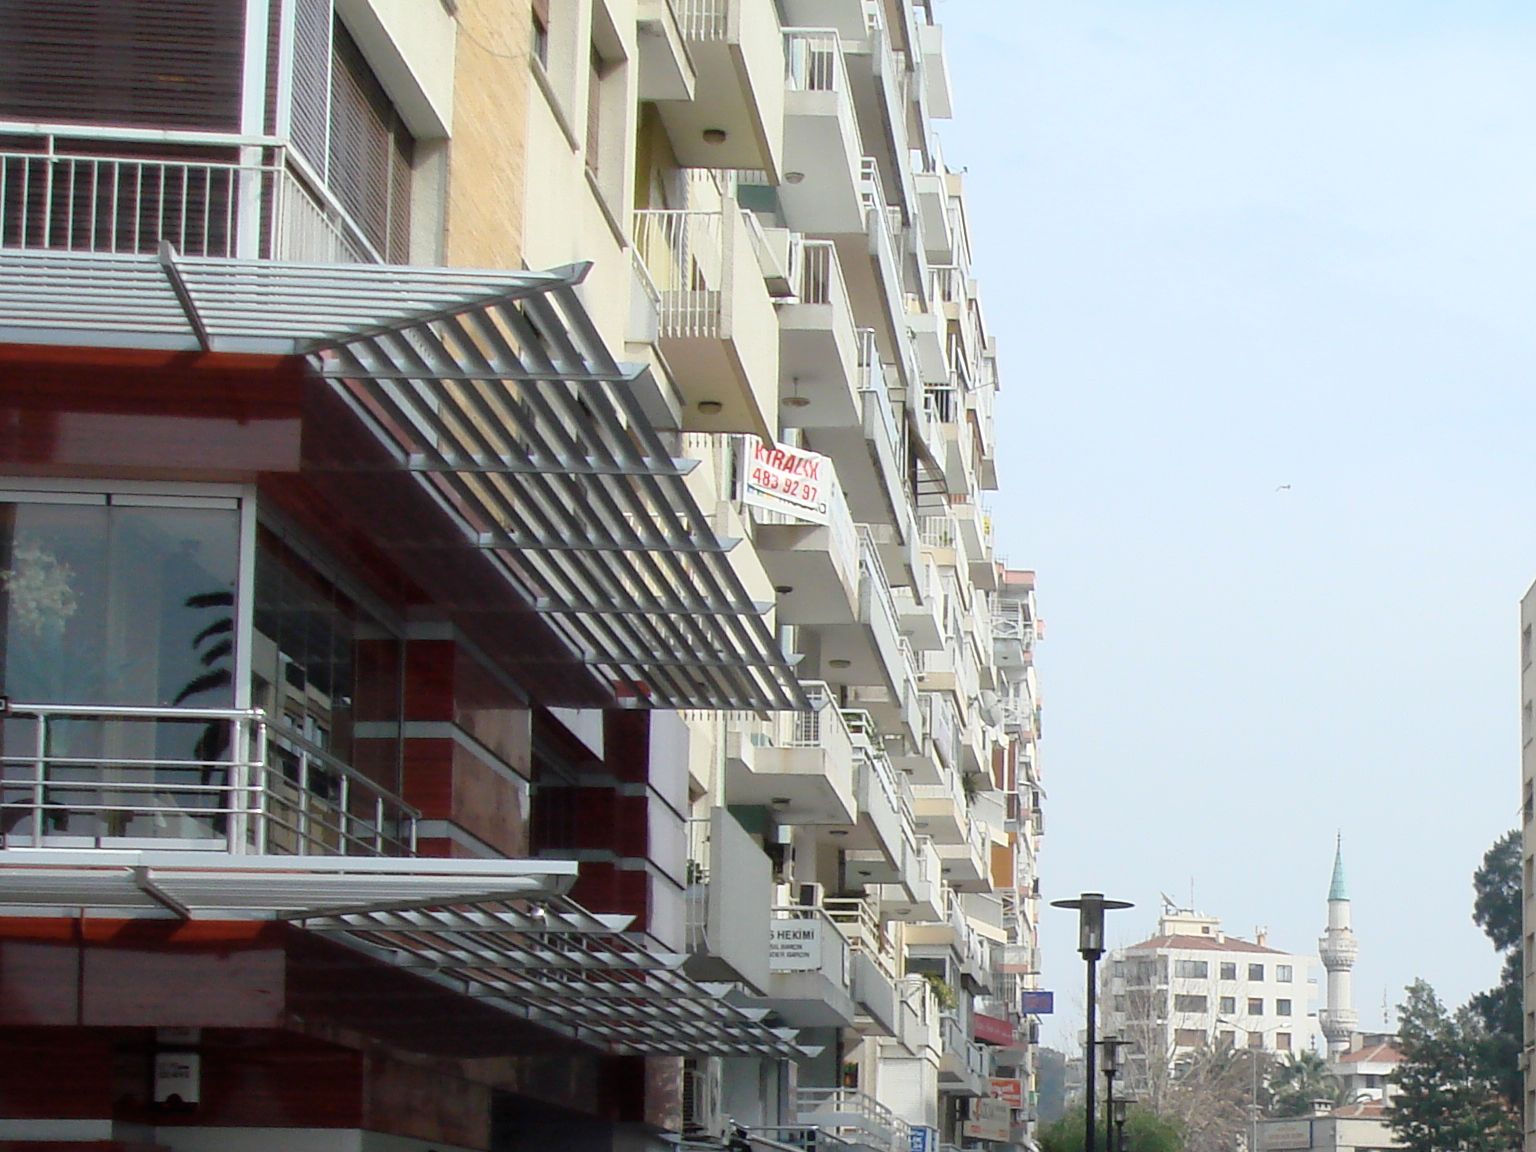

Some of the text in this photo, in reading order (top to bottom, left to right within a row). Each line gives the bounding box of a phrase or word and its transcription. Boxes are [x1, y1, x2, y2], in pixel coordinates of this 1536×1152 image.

[752, 467, 779, 489] 483
[783, 479, 800, 497] 92
[802, 485, 818, 503] 97
